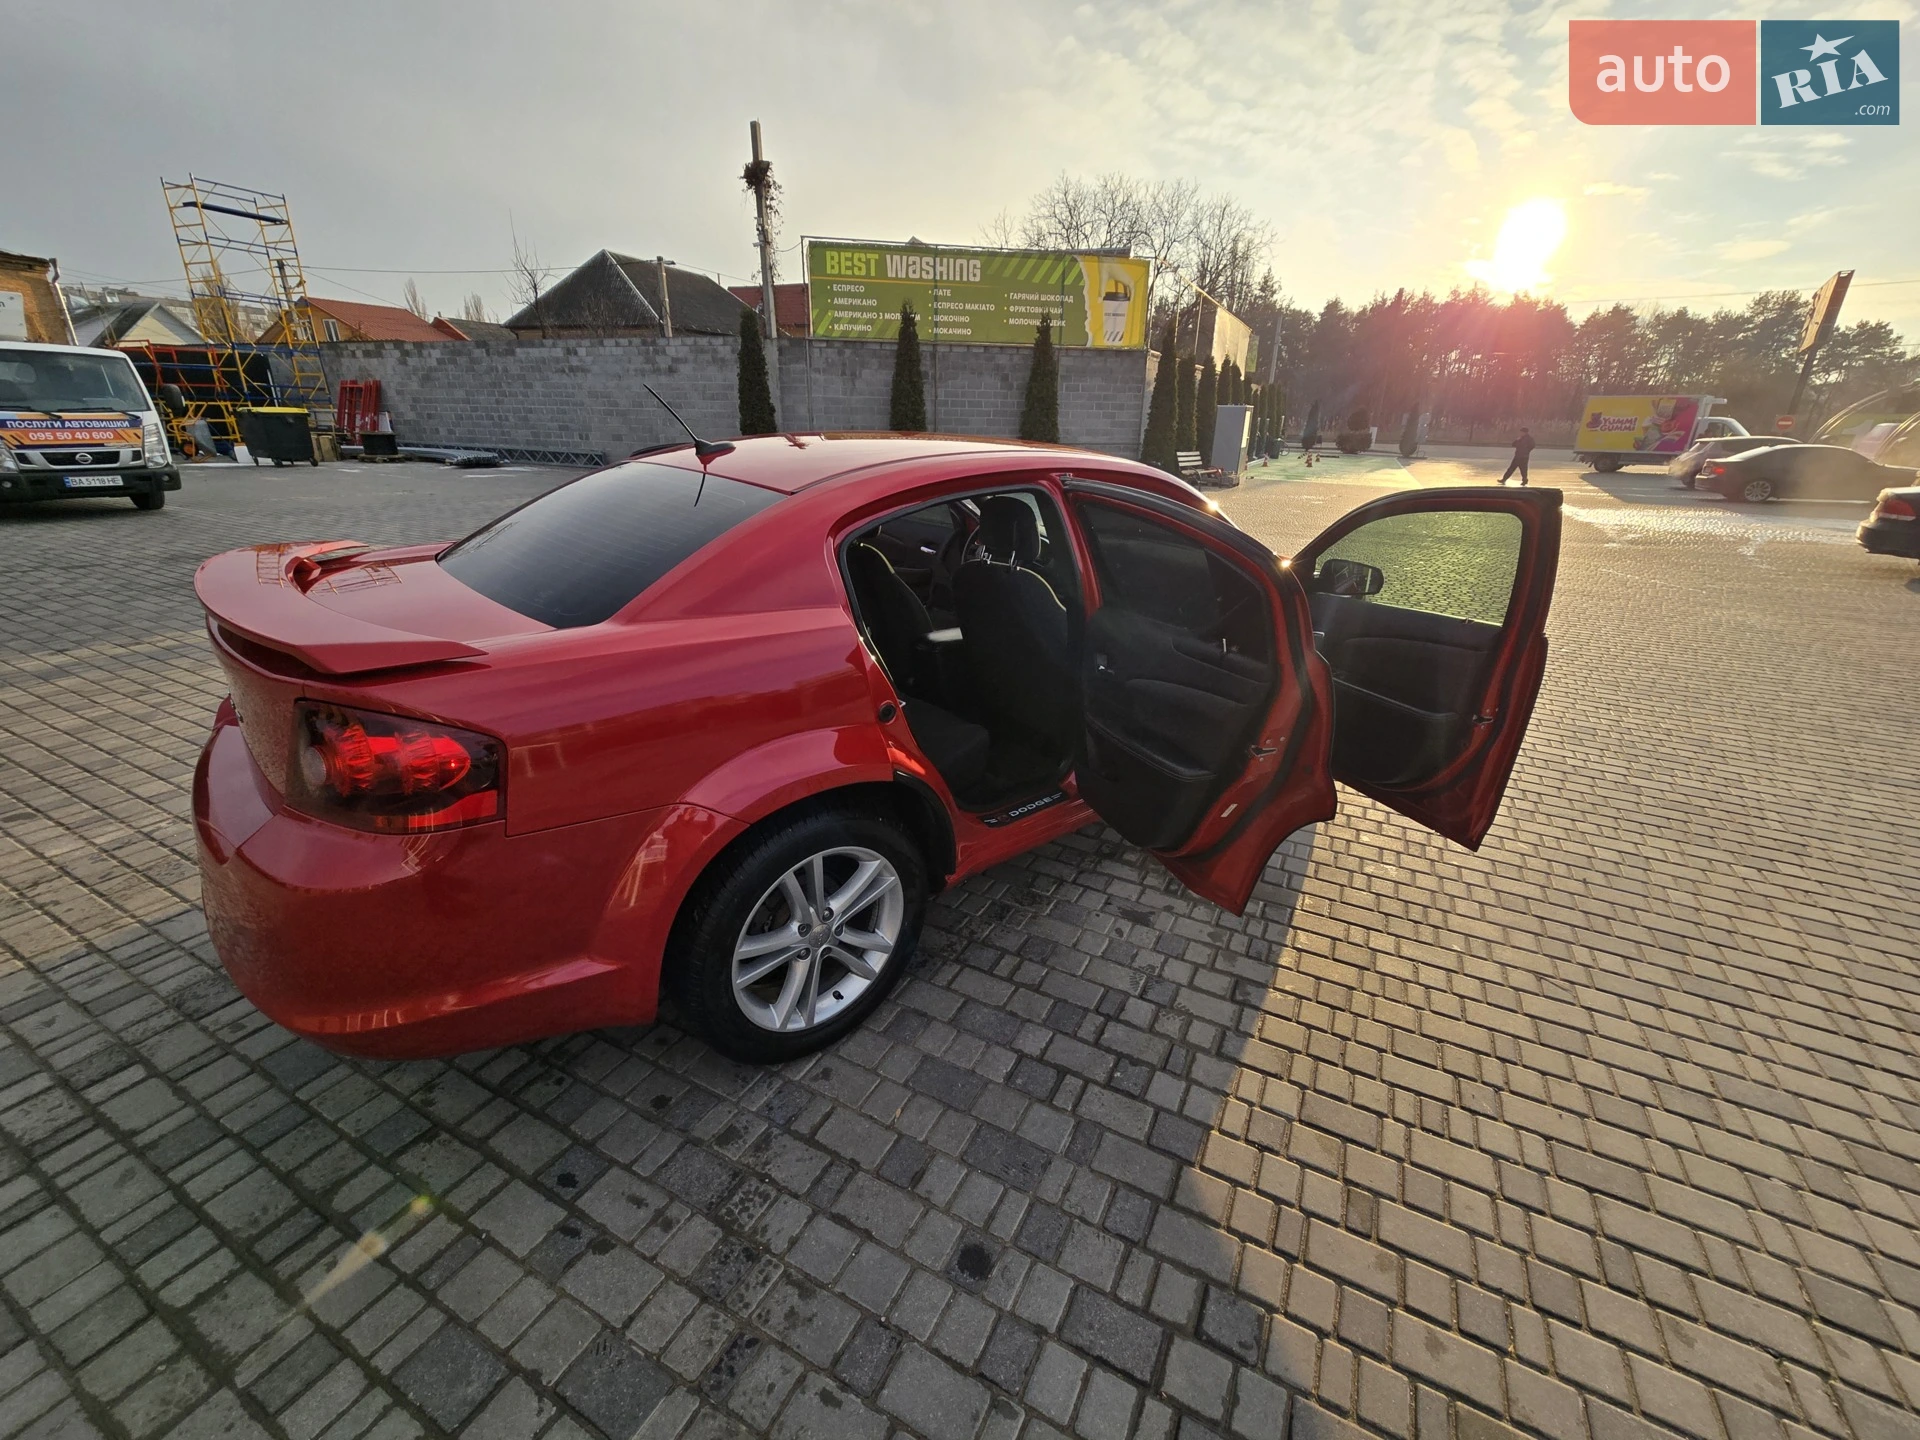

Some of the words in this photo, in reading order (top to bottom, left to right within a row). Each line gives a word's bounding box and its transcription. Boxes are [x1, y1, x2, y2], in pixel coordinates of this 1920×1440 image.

[825, 250, 879, 277] BEST
[832, 283, 865, 293] ЕСПРЕСО
[933, 288, 952, 296] ЛАТЕ
[833, 297, 878, 306] АМЕРИКАНО
[1009, 292, 1039, 300] ГАРЯЧИЙ
[1040, 294, 1074, 303] ШОКОЛАД
[933, 301, 964, 310] ЕСПРЕСО
[965, 303, 996, 311] МАКІАТО
[1049, 306, 1063, 314] ЧАЙ
[833, 310, 878, 319] АМЕРИКАНО
[833, 322, 872, 331] КАПУЧИНО
[933, 327, 972, 336] МОКАЧИНО
[6, 420, 62, 428] ПОСЛУГИ
[64, 420, 131, 428] АВТОВИШКИ
[28, 431, 54, 440] 095
[55, 431, 73, 440] 50
[74, 431, 90, 440] 40
[92, 431, 114, 440] 600
[1009, 797, 1052, 817] DODGE
